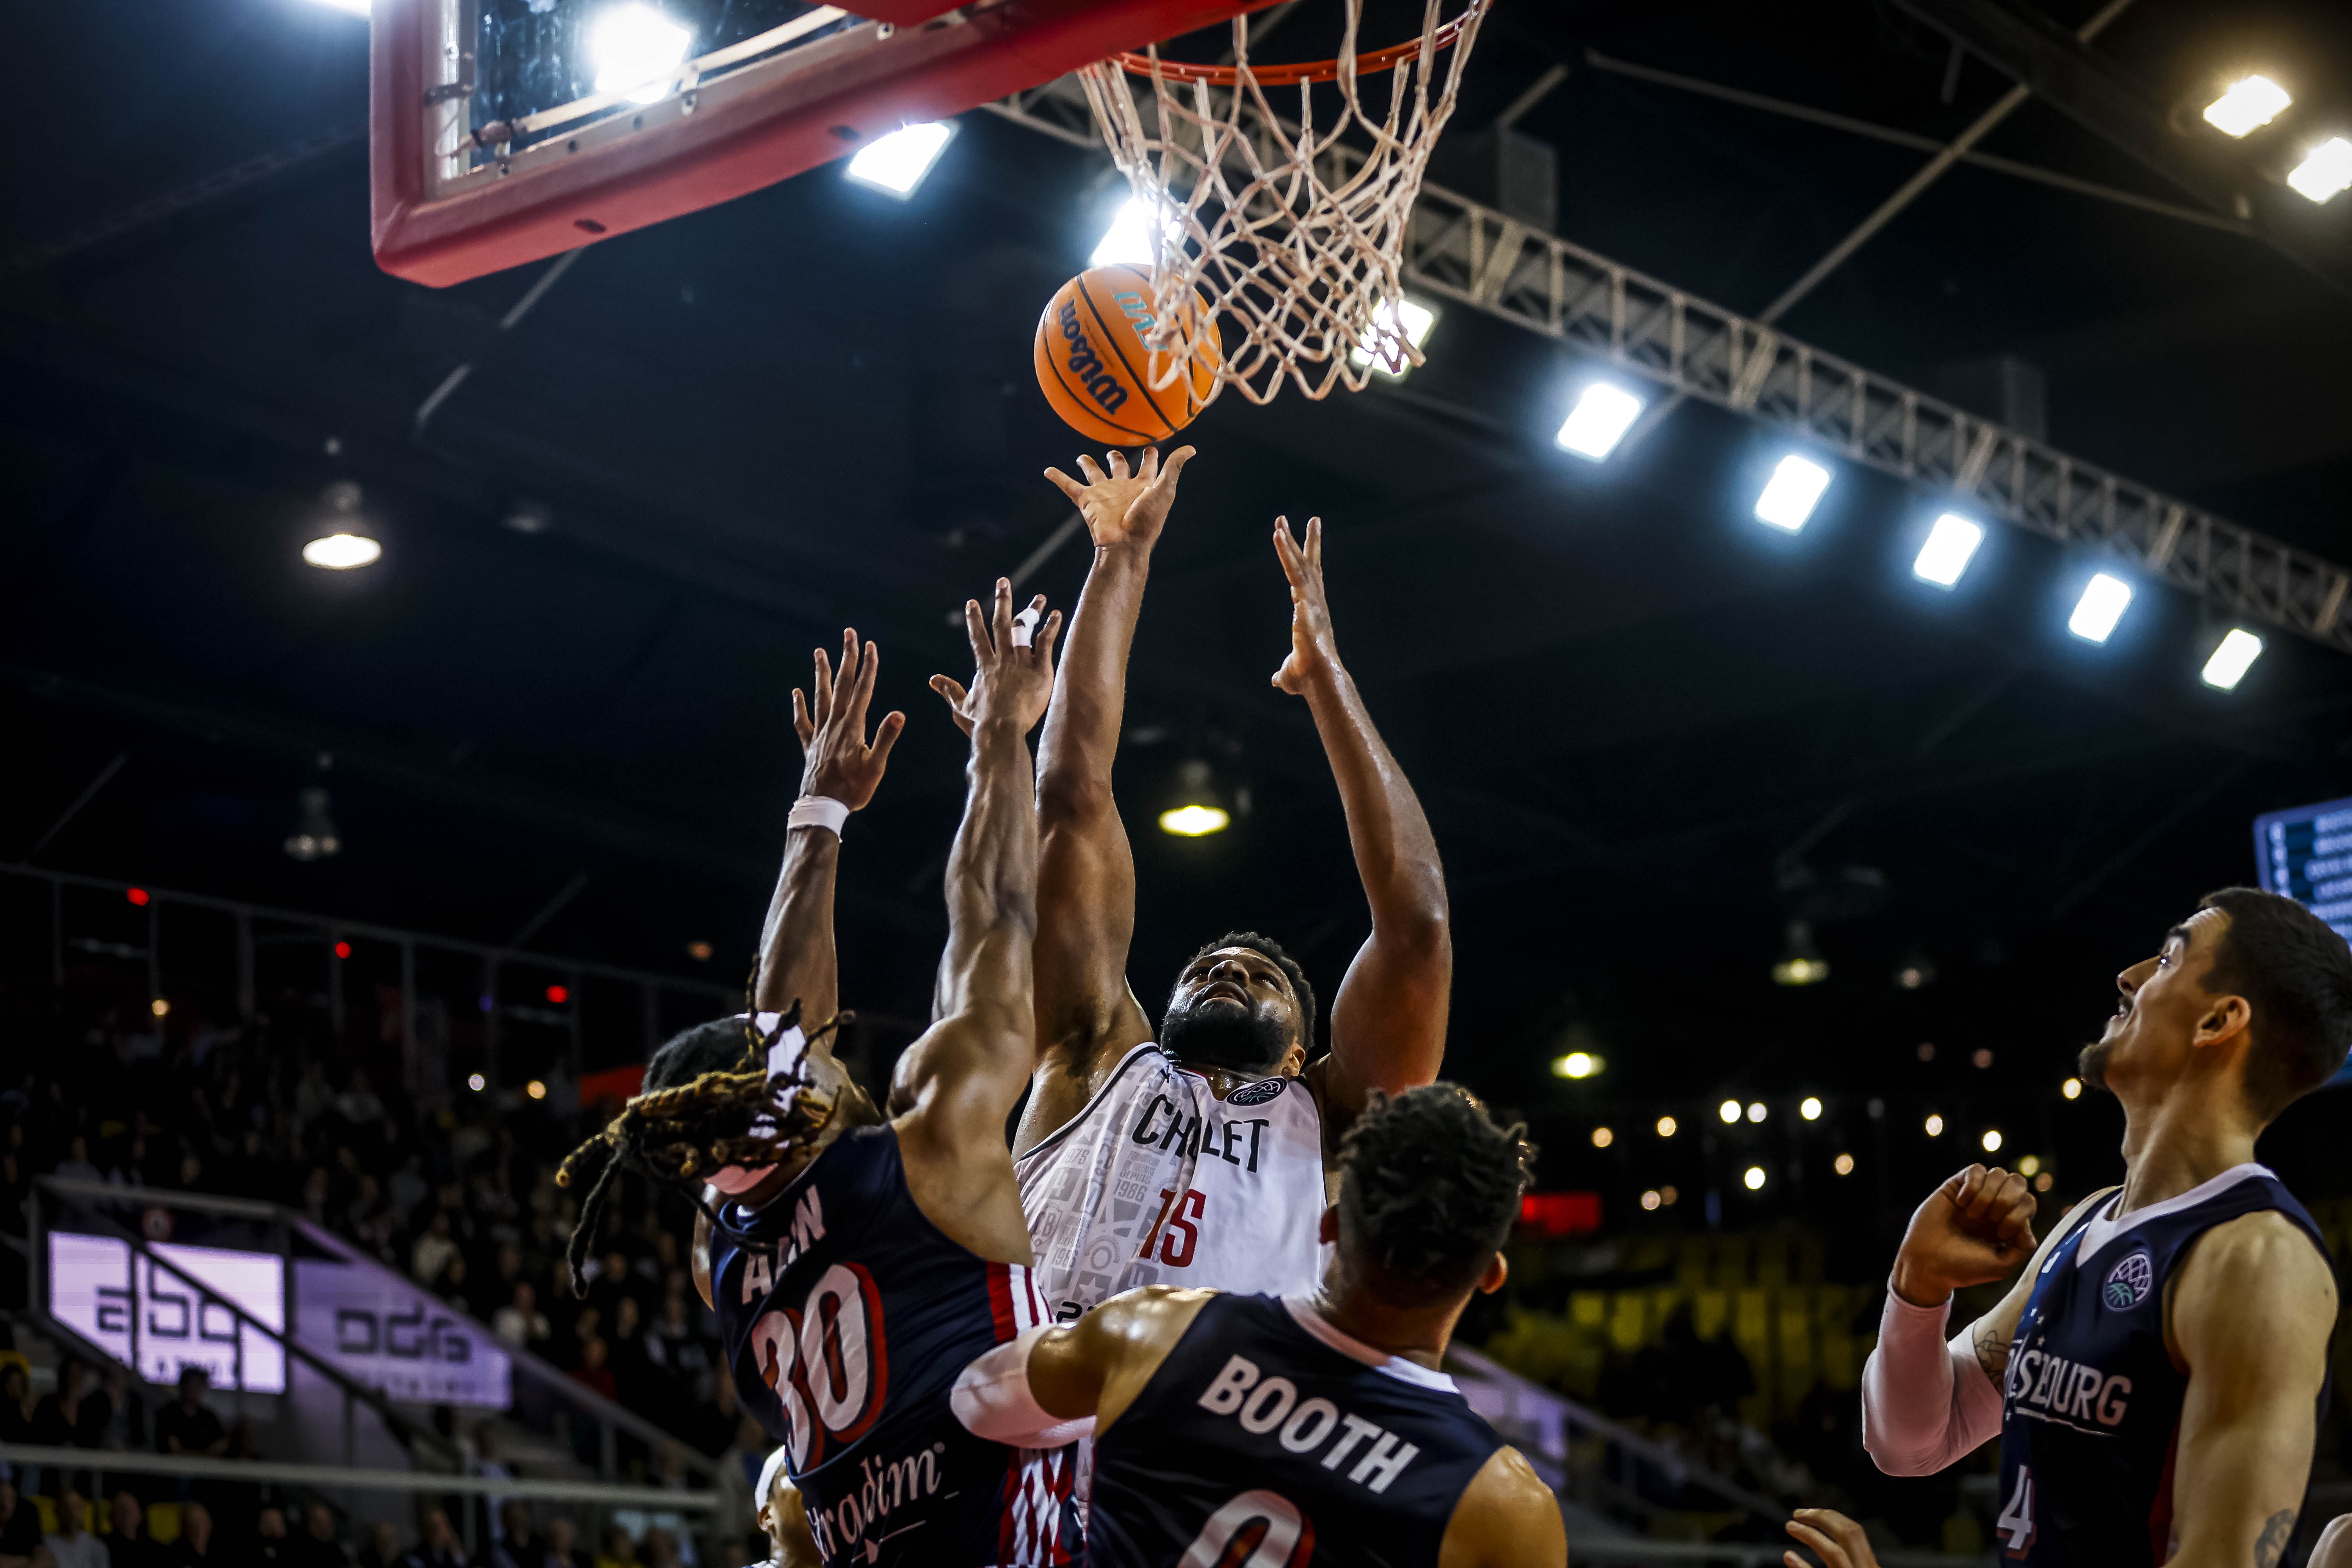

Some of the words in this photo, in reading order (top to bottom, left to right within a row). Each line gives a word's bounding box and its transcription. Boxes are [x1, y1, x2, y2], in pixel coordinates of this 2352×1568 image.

[1058, 298, 1128, 416] Wilson
[1112, 1178, 1147, 1202] 1986
[1138, 1188, 1206, 1268] 15
[752, 1261, 887, 1473] 30
[1198, 1354, 1420, 1495] BOOTH
[1997, 1465, 2035, 1558] 4
